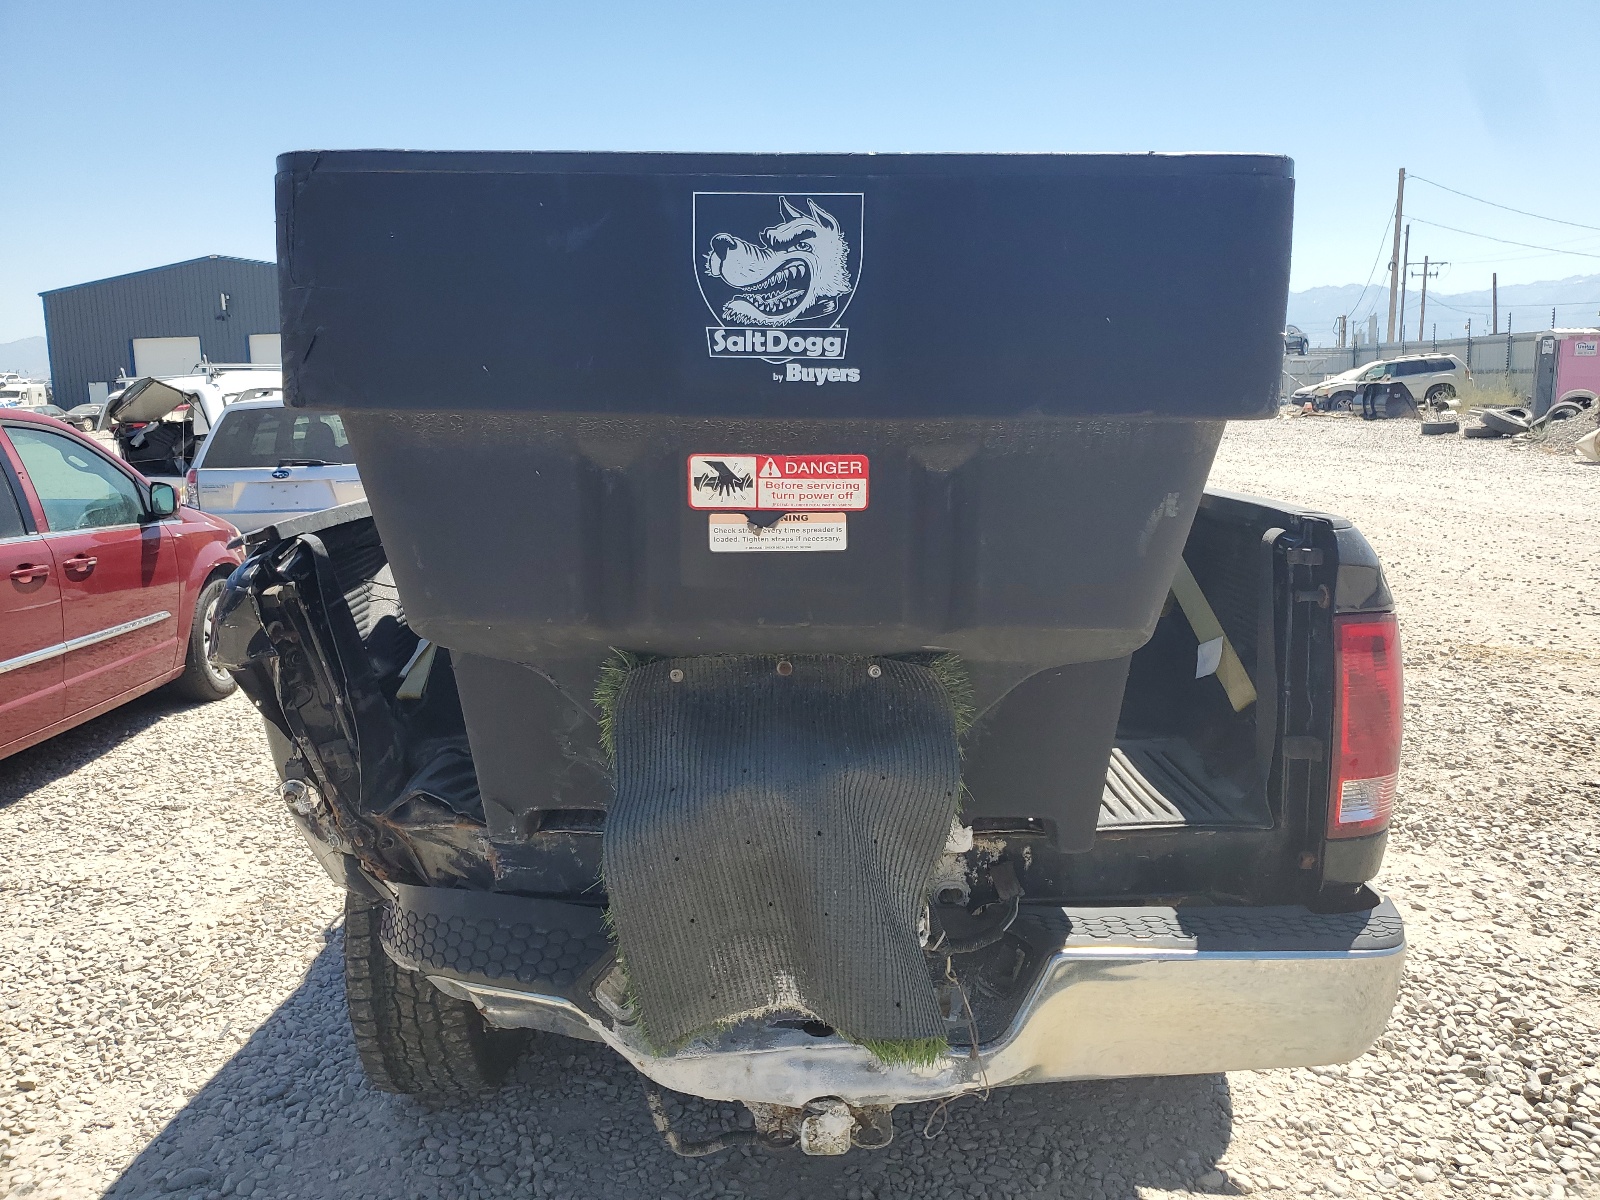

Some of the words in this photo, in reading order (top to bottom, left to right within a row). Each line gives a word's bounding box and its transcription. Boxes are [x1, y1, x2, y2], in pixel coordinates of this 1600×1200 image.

[713, 329, 842, 357] SaltDogg
[772, 372, 784, 384] by
[785, 363, 861, 386] Buyers
[785, 461, 862, 475] DANGER
[765, 481, 804, 490] Before
[806, 480, 860, 491] servicing
[771, 491, 795, 500] turn
[798, 491, 834, 502] power
[837, 491, 854, 500] off
[713, 527, 737, 535] Check
[762, 527, 783, 535] every
[784, 526, 801, 534] time
[802, 526, 835, 536] spreader
[836, 526, 843, 534] is
[742, 536, 769, 544] Tighten
[771, 536, 794, 544] straps
[802, 536, 841, 544] necessary.
